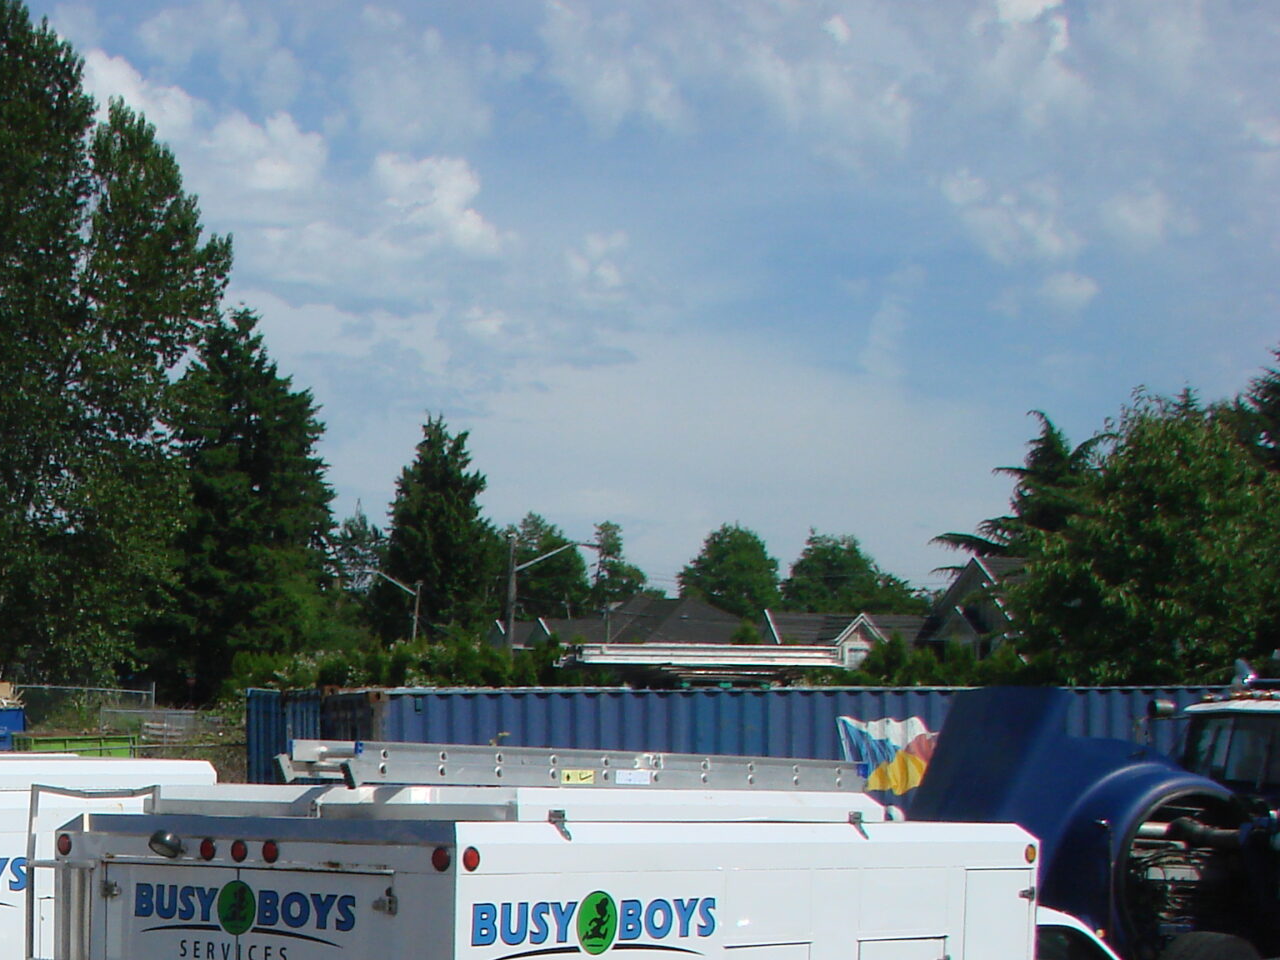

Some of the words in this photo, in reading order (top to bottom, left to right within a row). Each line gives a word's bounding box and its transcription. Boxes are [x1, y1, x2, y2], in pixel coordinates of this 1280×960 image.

[134, 883, 218, 921] BUSY
[256, 890, 356, 932] BOYS
[471, 902, 577, 946] BUSY
[619, 898, 716, 940] BOYS
